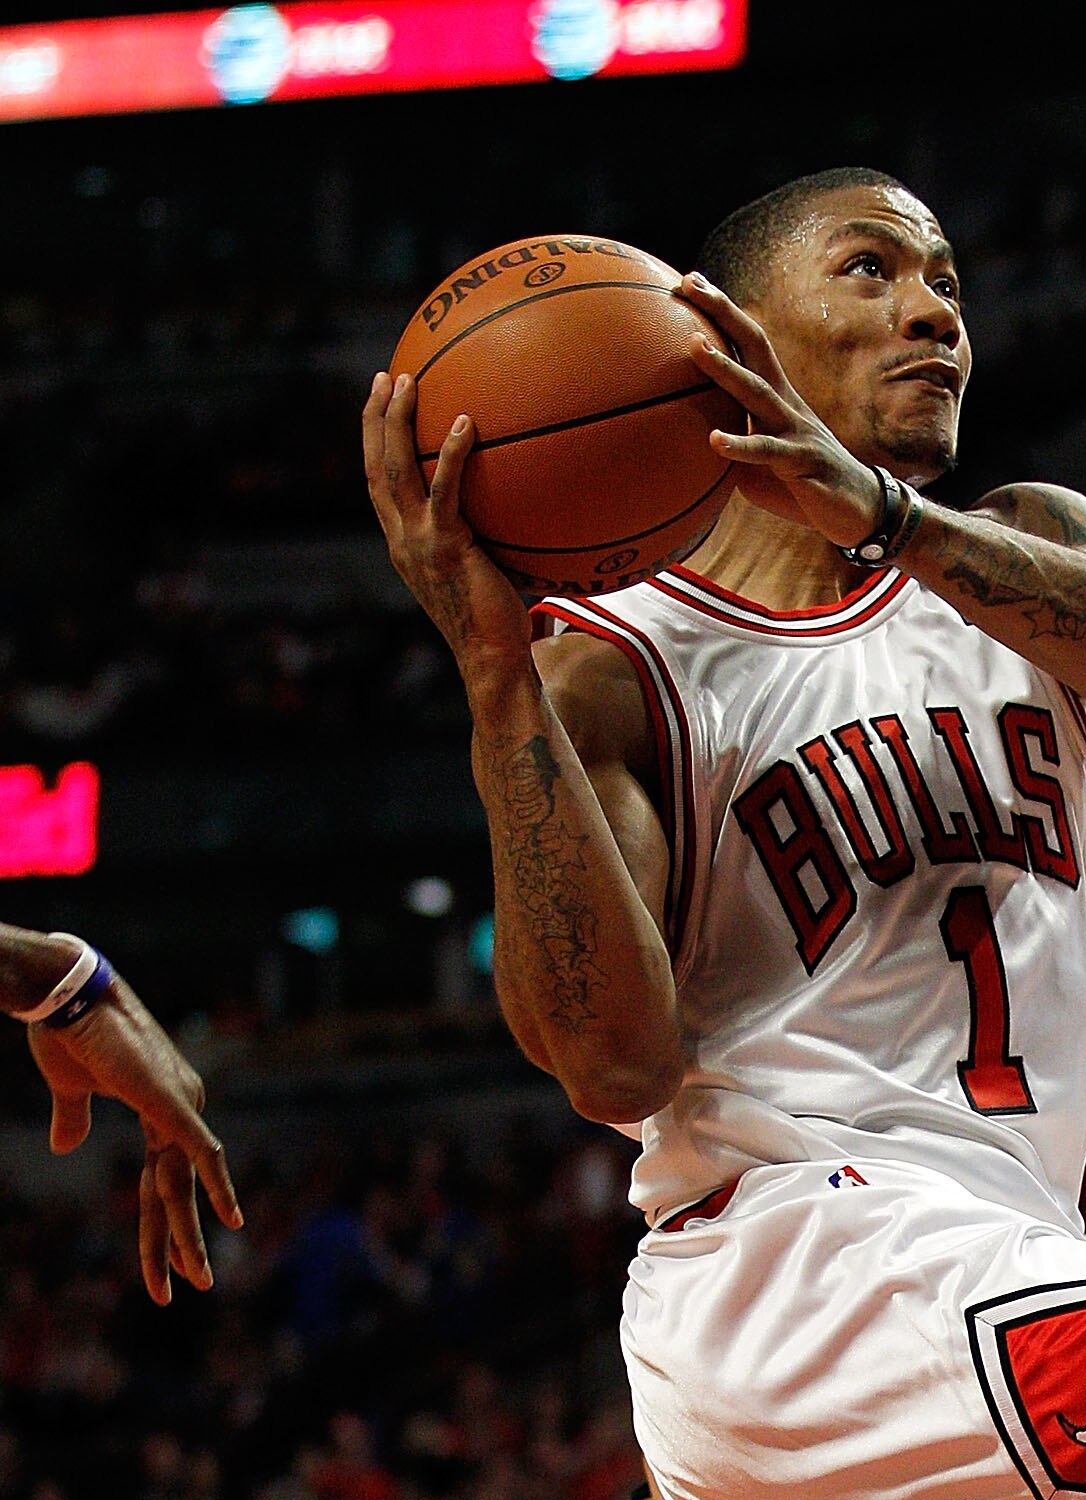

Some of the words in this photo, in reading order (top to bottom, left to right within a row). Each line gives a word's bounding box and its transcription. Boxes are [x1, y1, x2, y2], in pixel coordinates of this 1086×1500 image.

[421, 238, 645, 332] PALDING
[731, 702, 1081, 978] BULLS
[938, 885, 1039, 1117] 1
